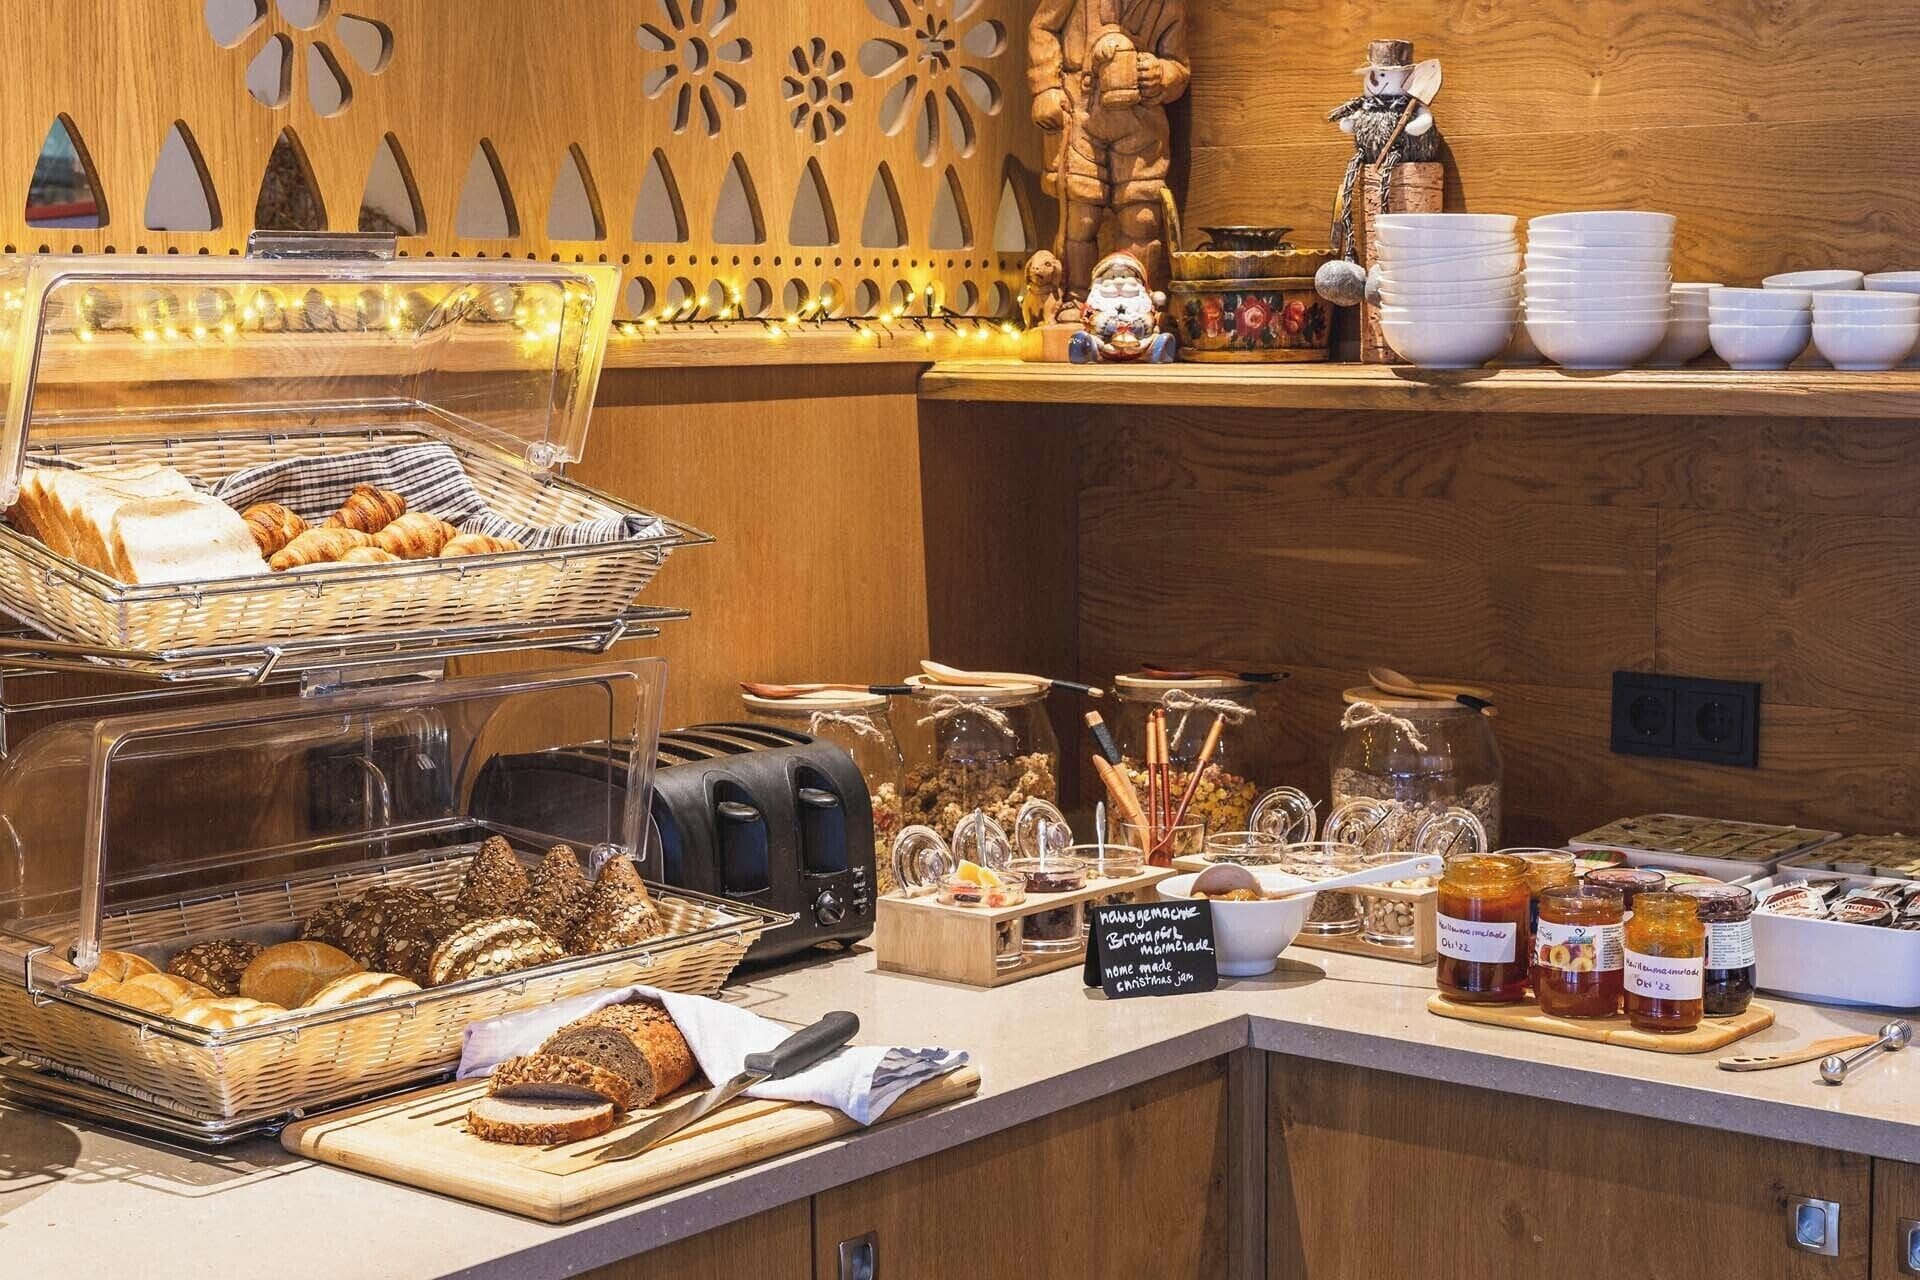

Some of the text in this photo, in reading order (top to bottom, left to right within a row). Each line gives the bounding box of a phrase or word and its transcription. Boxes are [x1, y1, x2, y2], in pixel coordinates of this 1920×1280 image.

[1844, 904, 1882, 912] nutell
[1139, 958, 1173, 974] made
[1174, 971, 1194, 987] jam
